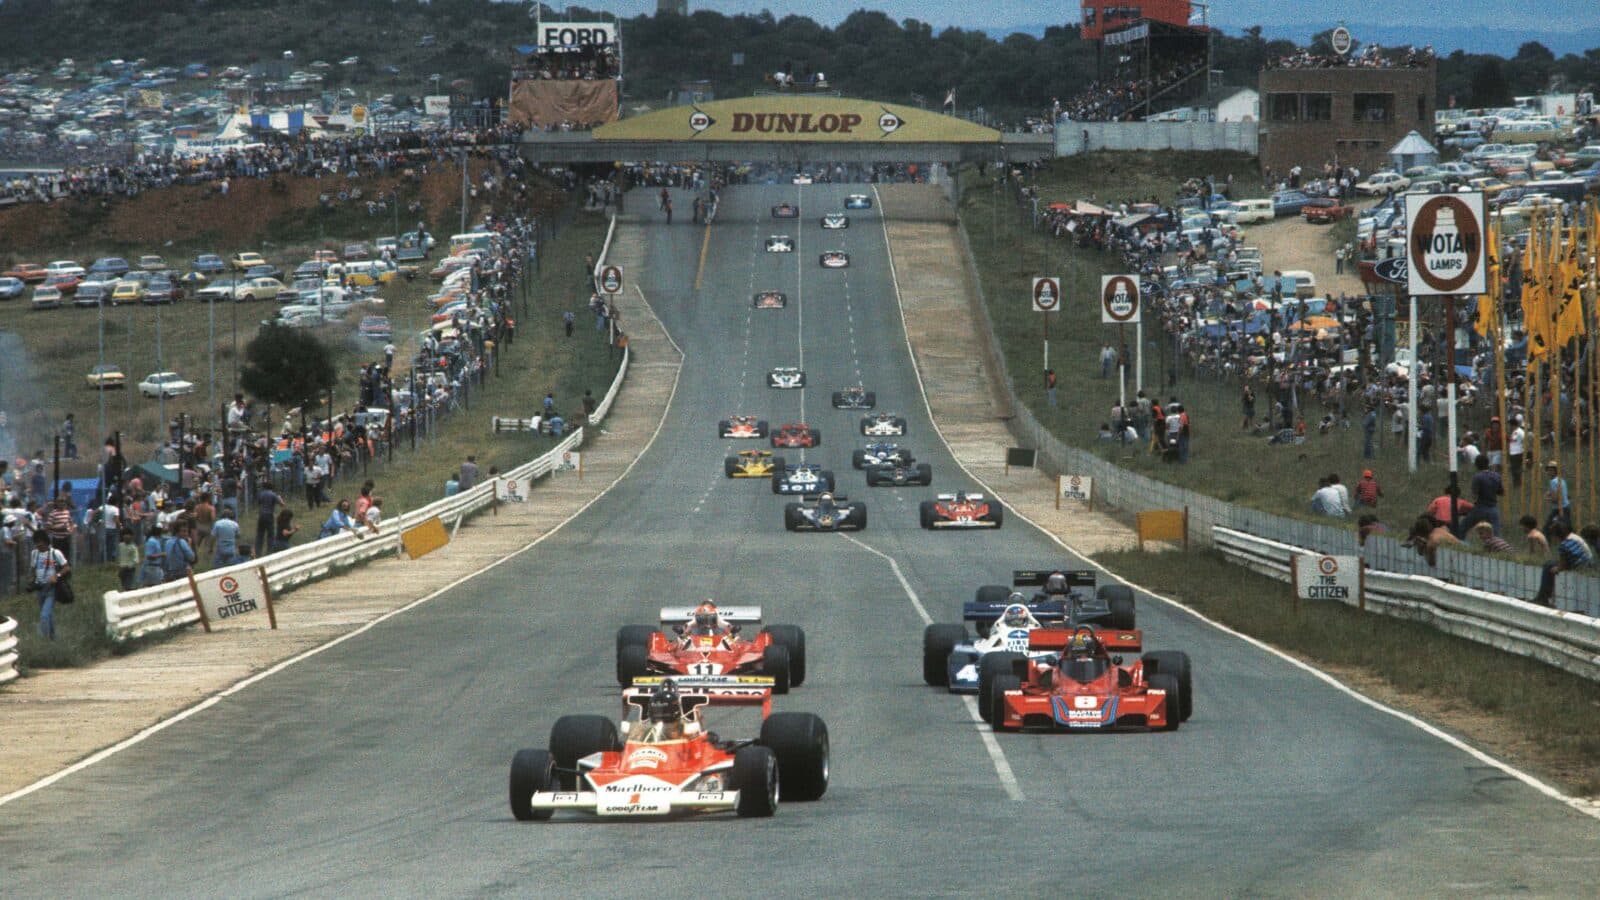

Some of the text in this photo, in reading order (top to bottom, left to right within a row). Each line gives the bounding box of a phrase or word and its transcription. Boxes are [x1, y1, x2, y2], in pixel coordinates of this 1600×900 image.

[545, 27, 607, 46] FORD
[731, 112, 862, 133] DUNLOP
[1416, 232, 1476, 255] WOTAN
[1430, 256, 1463, 271] LAMPS
[1319, 575, 1337, 585] THE
[224, 592, 242, 603] THE
[1308, 586, 1349, 598] CITIZEN
[217, 599, 257, 618] CITIZEN
[693, 664, 714, 675] 11
[955, 664, 979, 681] 4
[605, 783, 673, 793] Marlboro
[605, 804, 659, 813] GOODYEAR
